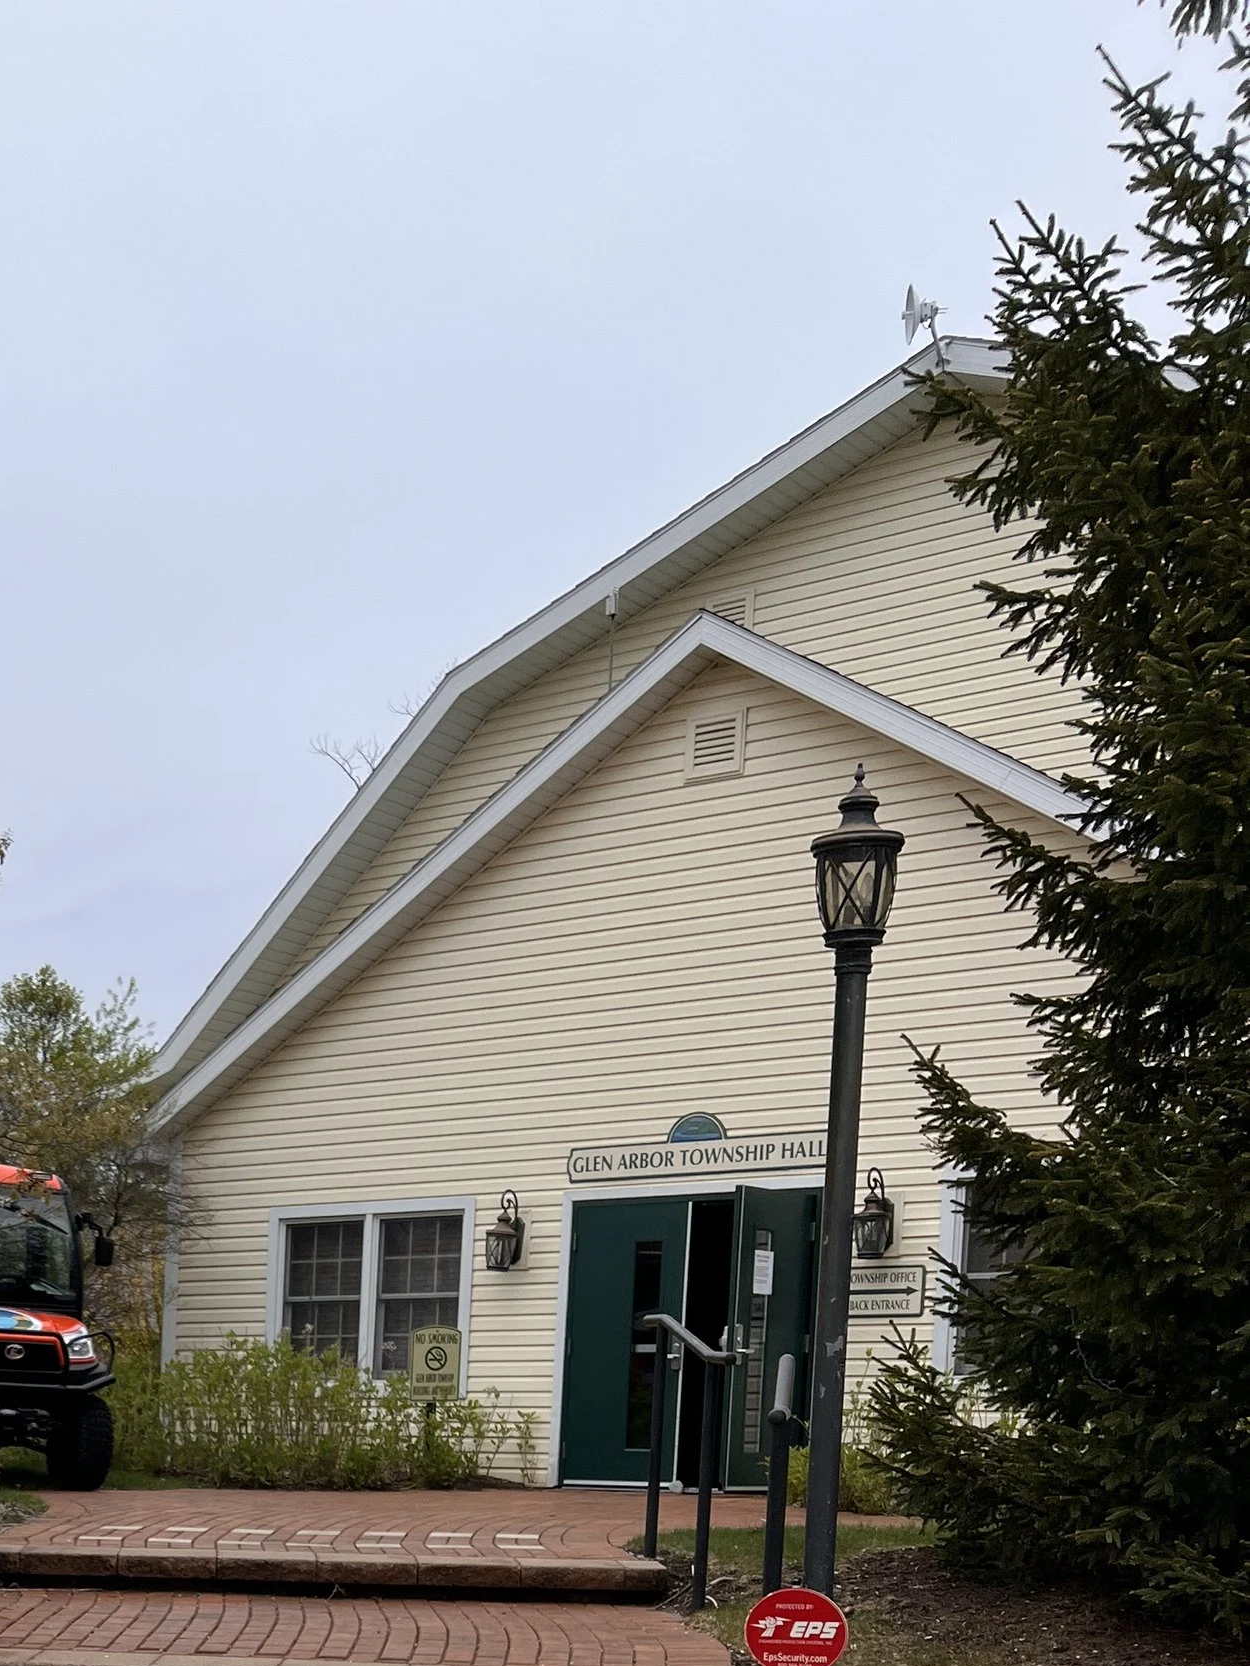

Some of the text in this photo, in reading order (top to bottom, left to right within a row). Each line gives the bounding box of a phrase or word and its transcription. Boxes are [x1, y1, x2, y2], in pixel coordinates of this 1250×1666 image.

[573, 1139, 827, 1174] GLEN ARBOR TOWNSHIP HALL
[850, 1271, 917, 1284] OWNSHIP OFFICE
[849, 1299, 910, 1311] BACK ENTRANCE
[415, 1333, 459, 1345] NO SMOKING
[789, 1620, 840, 1639] EPS
[763, 1651, 828, 1664] EpsSecurity.com
